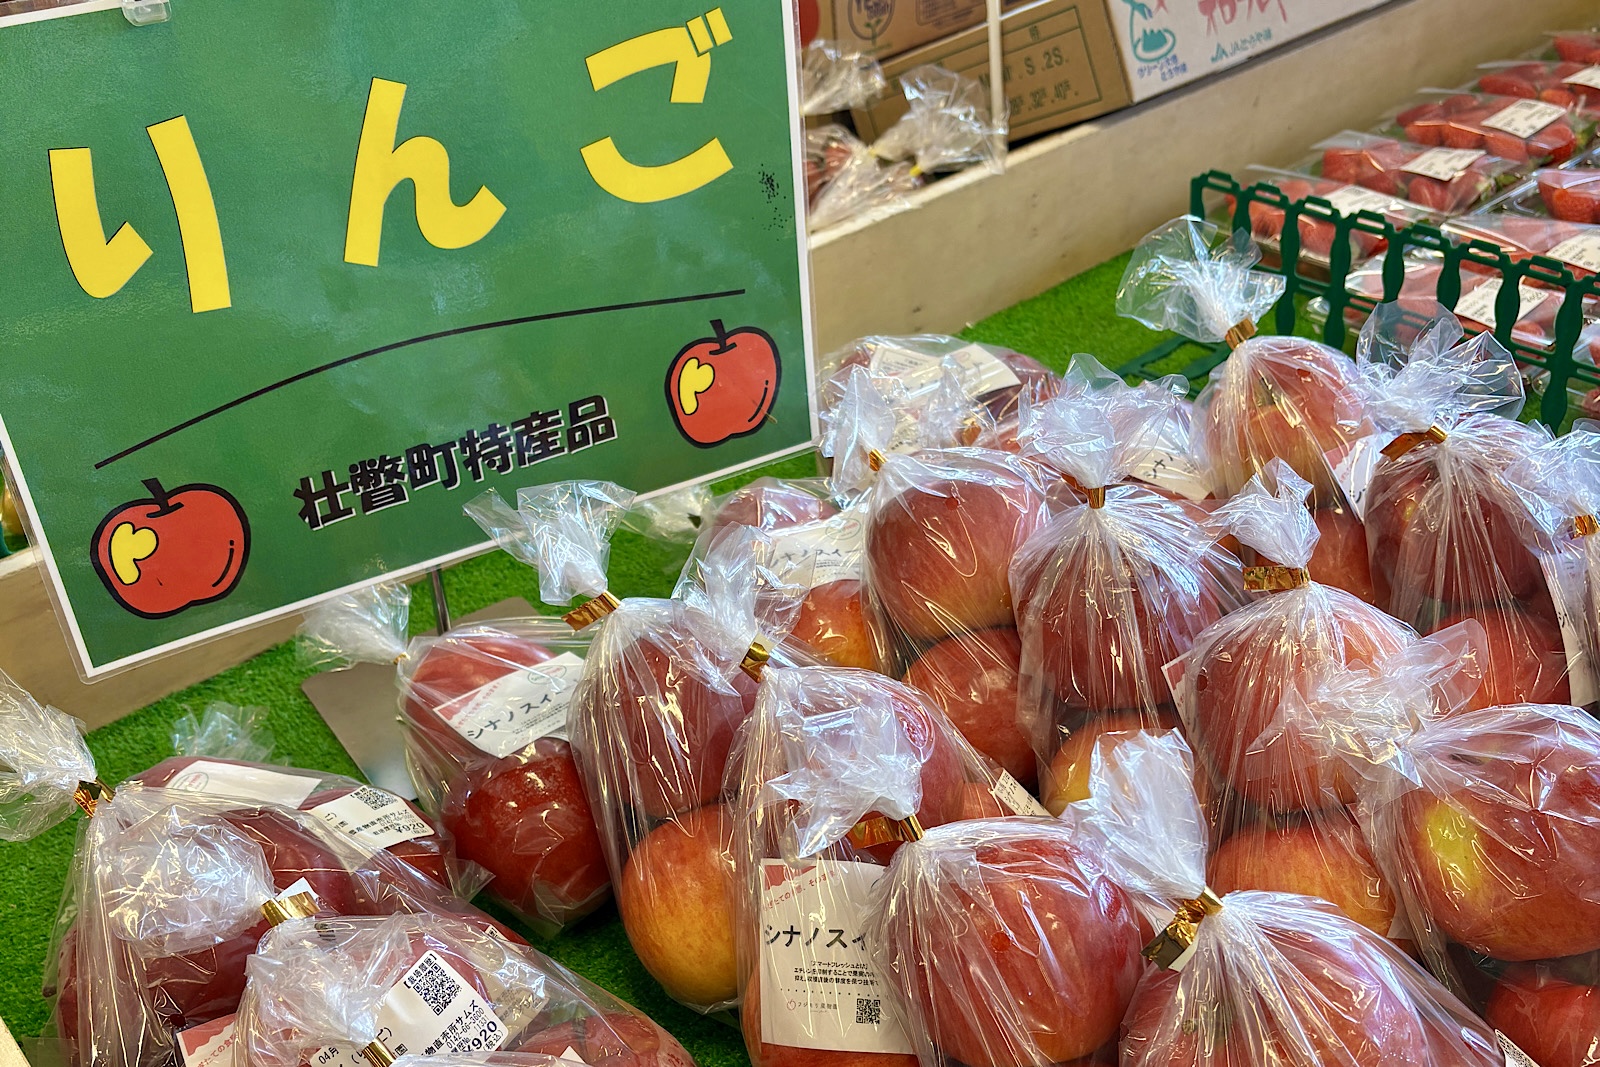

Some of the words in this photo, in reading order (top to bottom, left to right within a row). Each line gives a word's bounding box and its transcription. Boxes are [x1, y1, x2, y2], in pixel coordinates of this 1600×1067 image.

[49, 8, 734, 313] りんご
[293, 394, 617, 531] 壮瞥町特産品
[467, 678, 578, 740] シナノスイー
[403, 953, 437, 989] 【栽培履歴】
[422, 1000, 479, 1056] 物直売所サムズ
[446, 1007, 485, 1049] 0142-66-3600
[483, 1030, 503, 1052] (税込)
[318, 1046, 340, 1065] 04月
